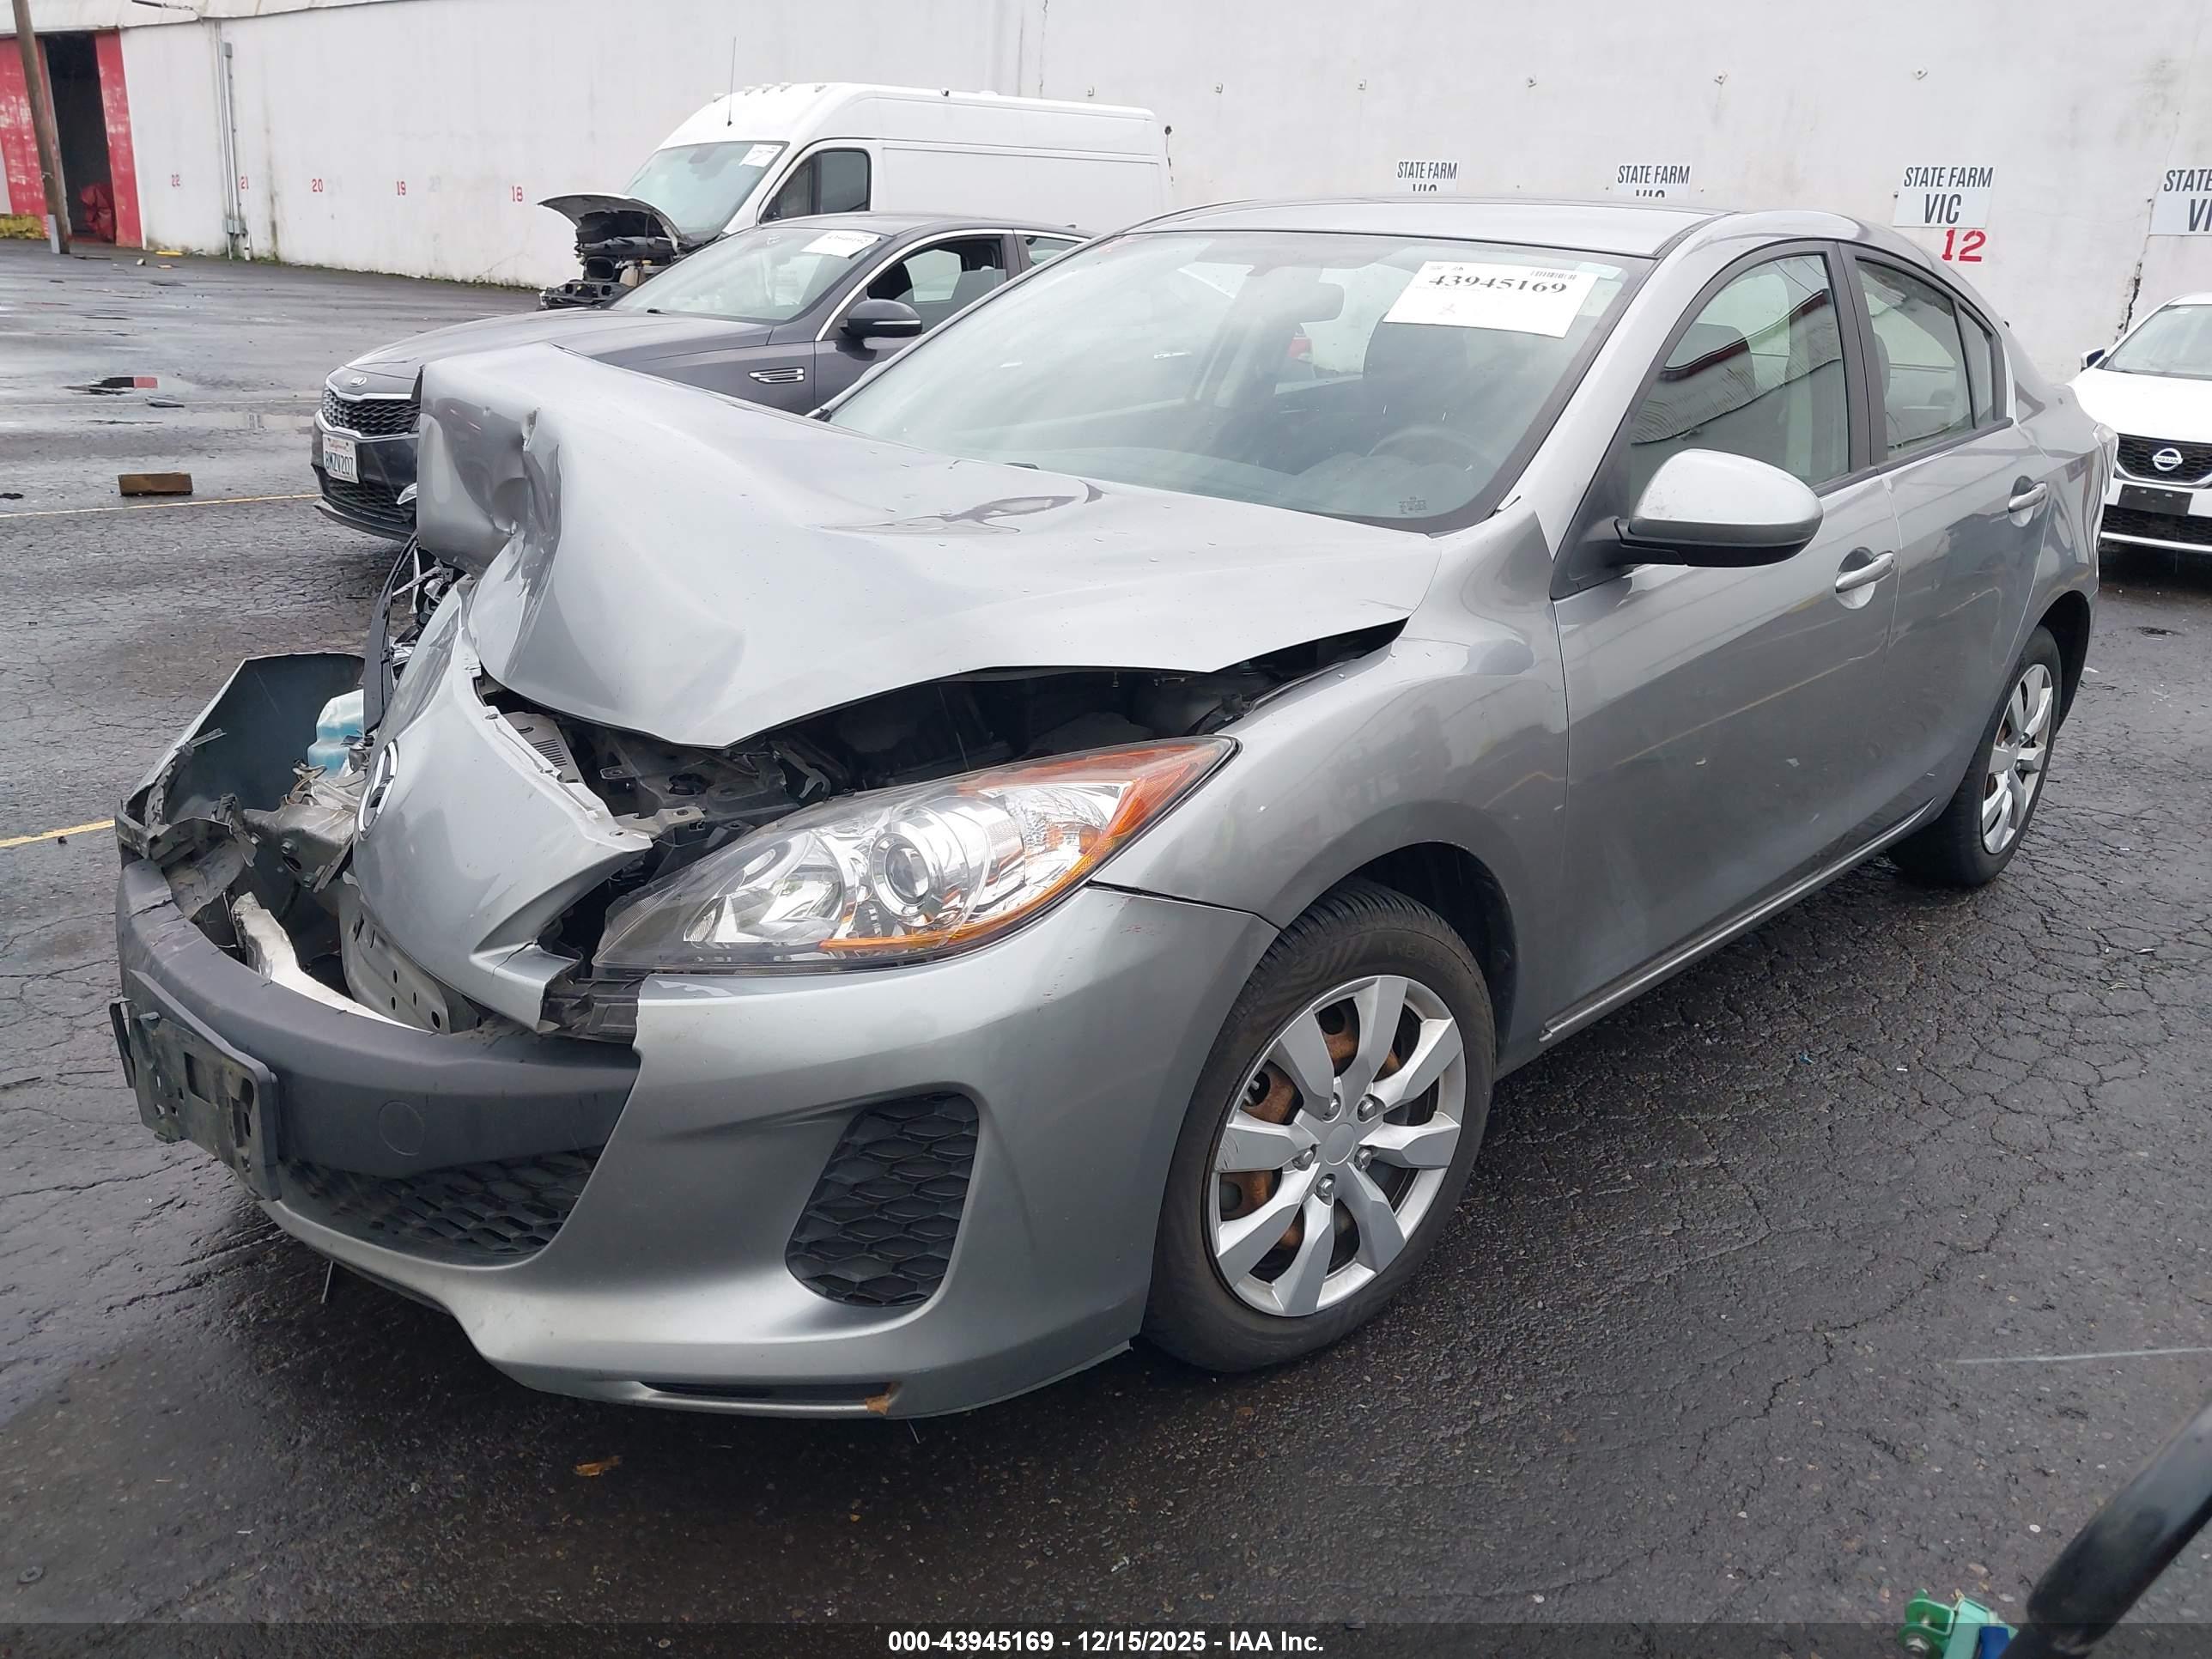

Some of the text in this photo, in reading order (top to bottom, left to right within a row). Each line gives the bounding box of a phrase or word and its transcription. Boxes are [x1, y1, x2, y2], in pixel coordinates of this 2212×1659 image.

[1397, 161, 1457, 179] STATE FARM
[1617, 165, 1691, 185] STATE FARM
[1904, 167, 1994, 188] STATE FARM
[240, 176, 249, 190] 21
[312, 178, 324, 192] 20
[397, 180, 406, 196] 19
[511, 185, 523, 202] 18
[1923, 193, 1962, 224] VIC
[2188, 198, 2212, 232] VI
[1942, 228, 1986, 263] 12
[1428, 273, 1568, 294] 43945169
